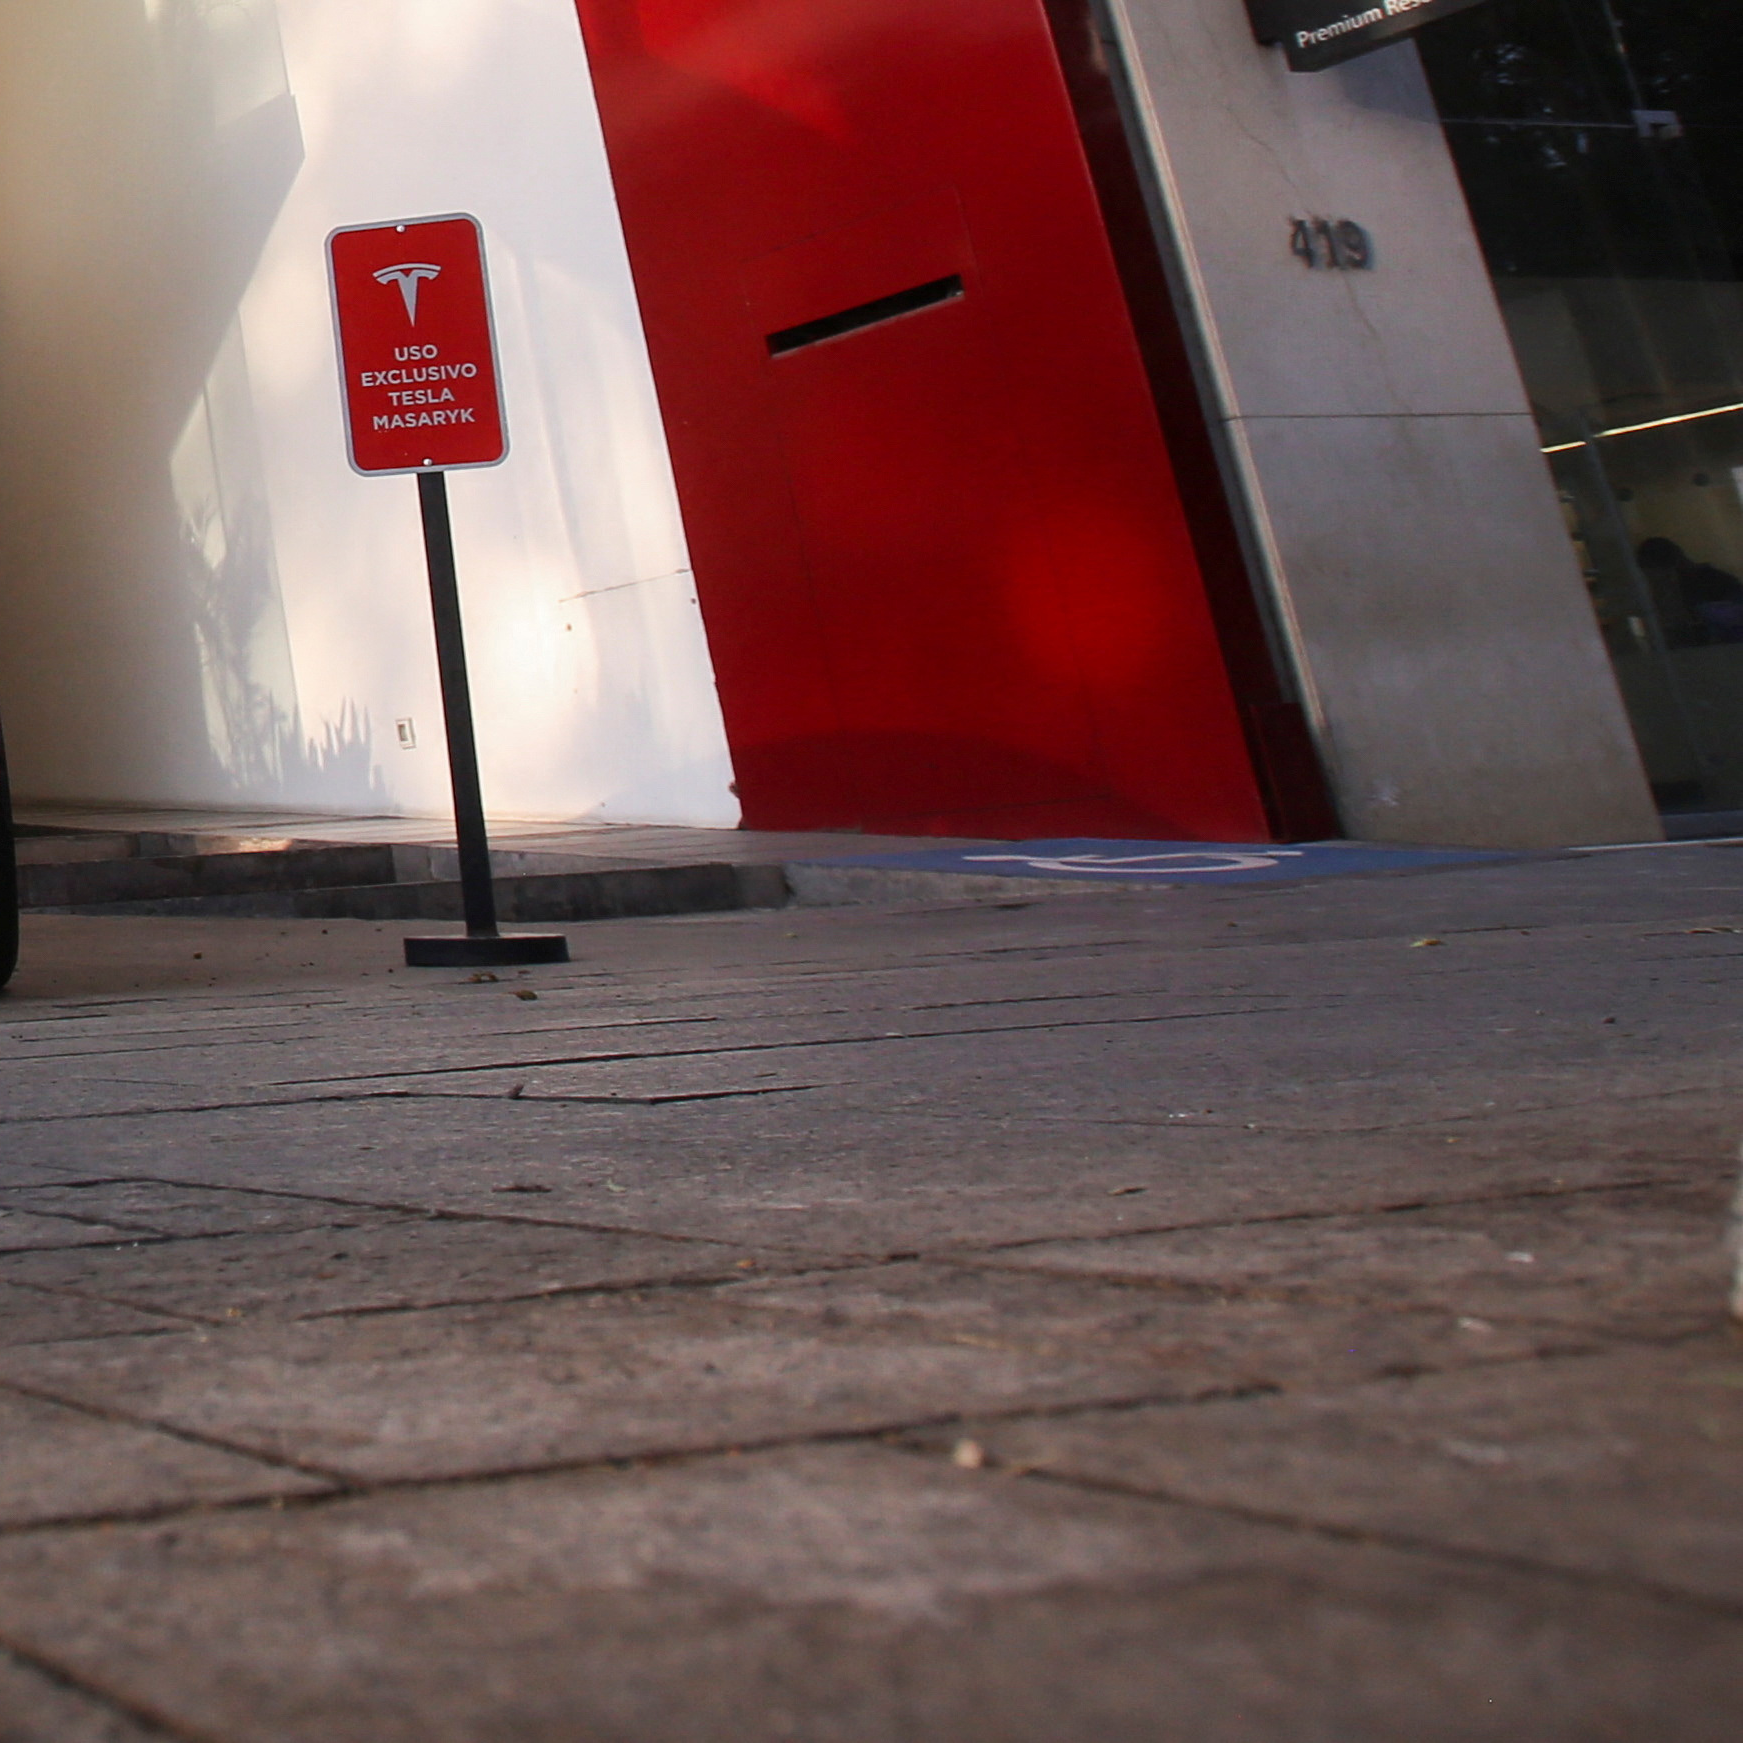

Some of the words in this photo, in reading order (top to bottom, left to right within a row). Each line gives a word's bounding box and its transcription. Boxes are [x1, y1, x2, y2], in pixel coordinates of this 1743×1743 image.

[1296, 6, 1383, 48] Premium
[1288, 216, 1371, 270] 419
[394, 344, 438, 361] USO
[361, 363, 477, 387] EXCLUSIVO
[388, 387, 455, 407] TESLA
[373, 408, 476, 430] MASARYK
